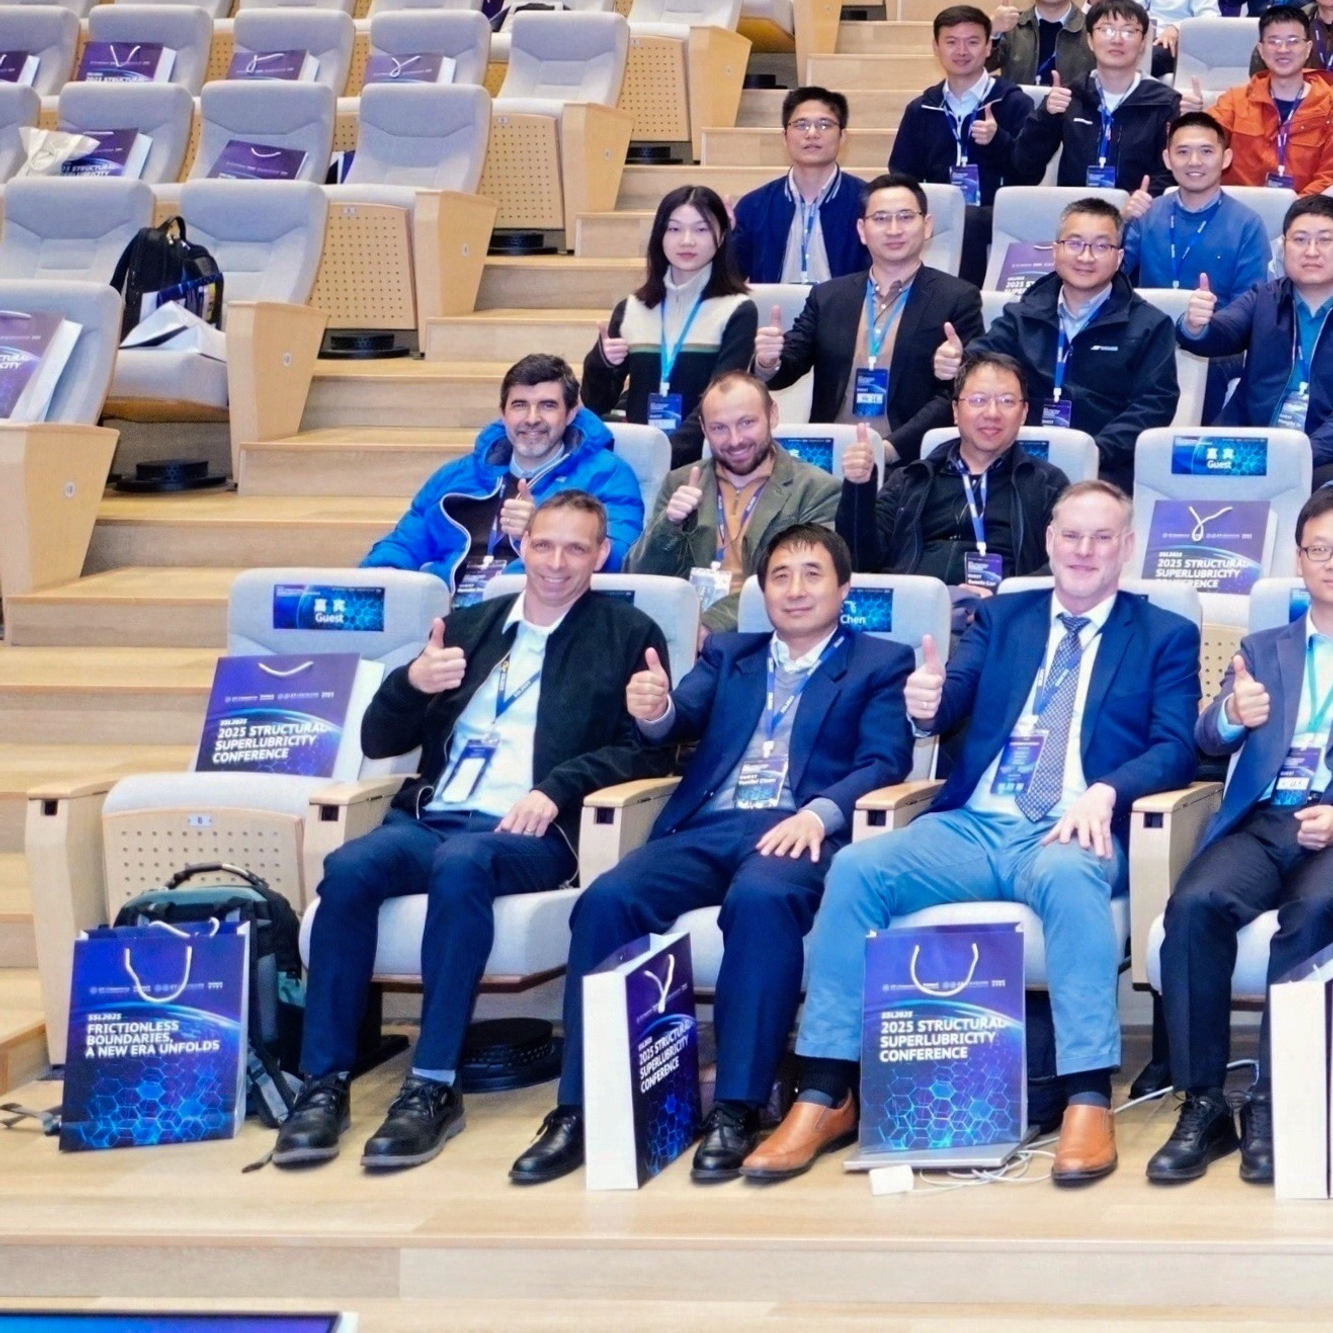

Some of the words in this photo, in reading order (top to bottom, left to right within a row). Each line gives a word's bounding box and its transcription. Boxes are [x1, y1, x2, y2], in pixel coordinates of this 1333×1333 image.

[1207, 460, 1232, 470] Guest
[1157, 558, 1182, 568] 2025
[1184, 558, 1249, 568] STRUCTURAL
[1155, 569, 1241, 579] SUPERLUBRICITY
[315, 612, 344, 624] Guest
[840, 614, 866, 625] Chen
[217, 726, 247, 739] 2025
[249, 722, 325, 737] STRUCTURAL
[214, 735, 317, 752] SUPERLUBRICITY
[212, 748, 289, 764] CONFERENCE
[87, 1021, 180, 1035] FRICTIONLESS
[881, 1021, 914, 1034] 2025
[917, 1017, 1005, 1032] STRUCTURAL
[86, 1033, 174, 1046] BOUNDARIES,
[880, 1032, 996, 1048] SUPERLUBRICITY
[85, 1048, 95, 1058] A
[98, 1046, 128, 1058] NEW
[131, 1045, 156, 1055] ERA
[160, 1040, 220, 1054] UNFOLDS
[639, 1046, 654, 1066] 2025
[640, 1034, 689, 1080] SUPERLUBRICITY
[879, 1047, 968, 1062] CONFERENCE
[641, 1055, 680, 1094] CONFERENCE
